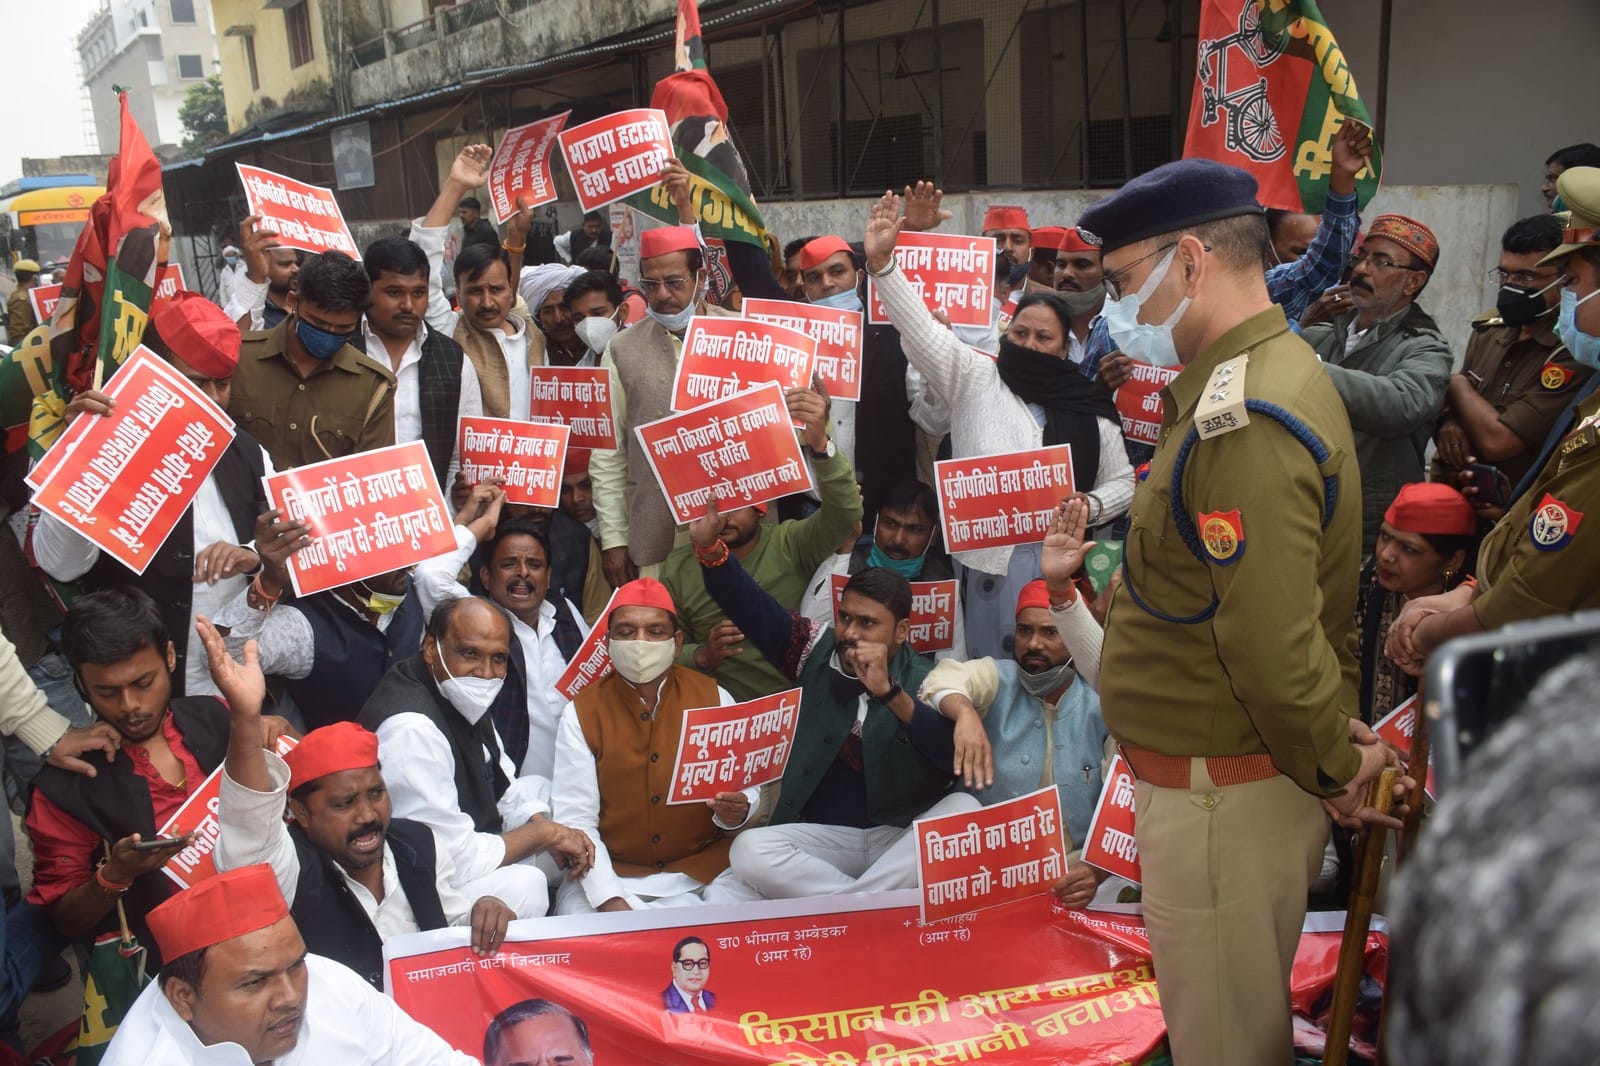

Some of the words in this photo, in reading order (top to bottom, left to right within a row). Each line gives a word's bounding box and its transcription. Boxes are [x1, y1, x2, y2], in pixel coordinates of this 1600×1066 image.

[568, 128, 616, 165] भाजपा
[616, 115, 664, 149] हटाओ
[936, 242, 990, 274] समर्थन
[934, 282, 969, 316] मूल्य
[971, 278, 988, 310] दो
[808, 315, 857, 348] समर्थन
[690, 327, 733, 359] किसान
[732, 330, 772, 364] विरोधी
[773, 343, 810, 379] कानून
[841, 352, 857, 383] दो
[129, 378, 184, 430] किसान
[533, 376, 559, 400] बिजली
[560, 382, 573, 401] का
[575, 382, 592, 408] बढ़ा
[591, 376, 606, 403] रेट
[687, 373, 721, 400] वापस
[1142, 392, 1162, 413] की
[463, 426, 501, 454] किसानों
[499, 430, 515, 450] को
[513, 436, 544, 457] उत्पाद
[543, 439, 560, 459] का
[570, 417, 596, 437] वापस
[596, 412, 611, 438] लो
[652, 435, 682, 459] गन्ना
[677, 416, 724, 454] किसानों
[721, 416, 740, 438] का
[739, 403, 781, 433] बकाया
[89, 415, 150, 483] आत्महत्या
[161, 421, 215, 496] मोदी-योगी
[697, 450, 720, 479] सूद
[719, 441, 751, 470] सहित
[65, 471, 111, 513] करता
[281, 475, 343, 520] किसानों
[340, 472, 365, 508] को
[362, 469, 407, 503] उत्पाद
[403, 464, 428, 491] का
[527, 468, 546, 496] मूल्य
[546, 464, 557, 490] दो
[673, 486, 713, 517] भुगतान
[776, 457, 802, 482] करो
[943, 466, 998, 510] पूंजीपतियों
[999, 470, 1021, 494] द्वारा
[1021, 459, 1052, 490] खरीद
[1052, 463, 1068, 487] पर
[57, 500, 97, 525] है
[118, 481, 168, 536] सरकार
[949, 515, 971, 543] रोक
[971, 507, 1033, 541] लगाओ-रोक
[109, 527, 145, 554] में
[326, 529, 358, 572] मूल्य
[401, 508, 429, 551] मूल्य
[426, 498, 445, 533] दो
[934, 617, 950, 640] दो
[566, 674, 589, 697] गन्ना
[689, 718, 749, 759] न्यूनतम
[749, 699, 796, 740] समर्थन
[681, 759, 716, 796] मूल्य
[743, 746, 772, 785] मूल्य
[772, 735, 790, 766] दो
[925, 822, 982, 864] बिजली
[984, 821, 1006, 850] का
[1007, 814, 1036, 851] बढ़ा
[1033, 805, 1056, 838] रेट
[927, 876, 969, 906] वापस
[1000, 859, 1041, 890] वापस
[1041, 847, 1062, 881] लो
[744, 930, 790, 946] भीमराव
[755, 949, 789, 966] (अमर
[792, 944, 812, 961] रहे)
[919, 931, 950, 946] (अमर
[952, 926, 971, 942] रहे)
[406, 957, 476, 984] समाजवादी
[478, 951, 507, 971] पार्टी
[738, 1005, 884, 1046] किसान
[890, 988, 949, 1028] की
[959, 985, 1041, 1019] आय
